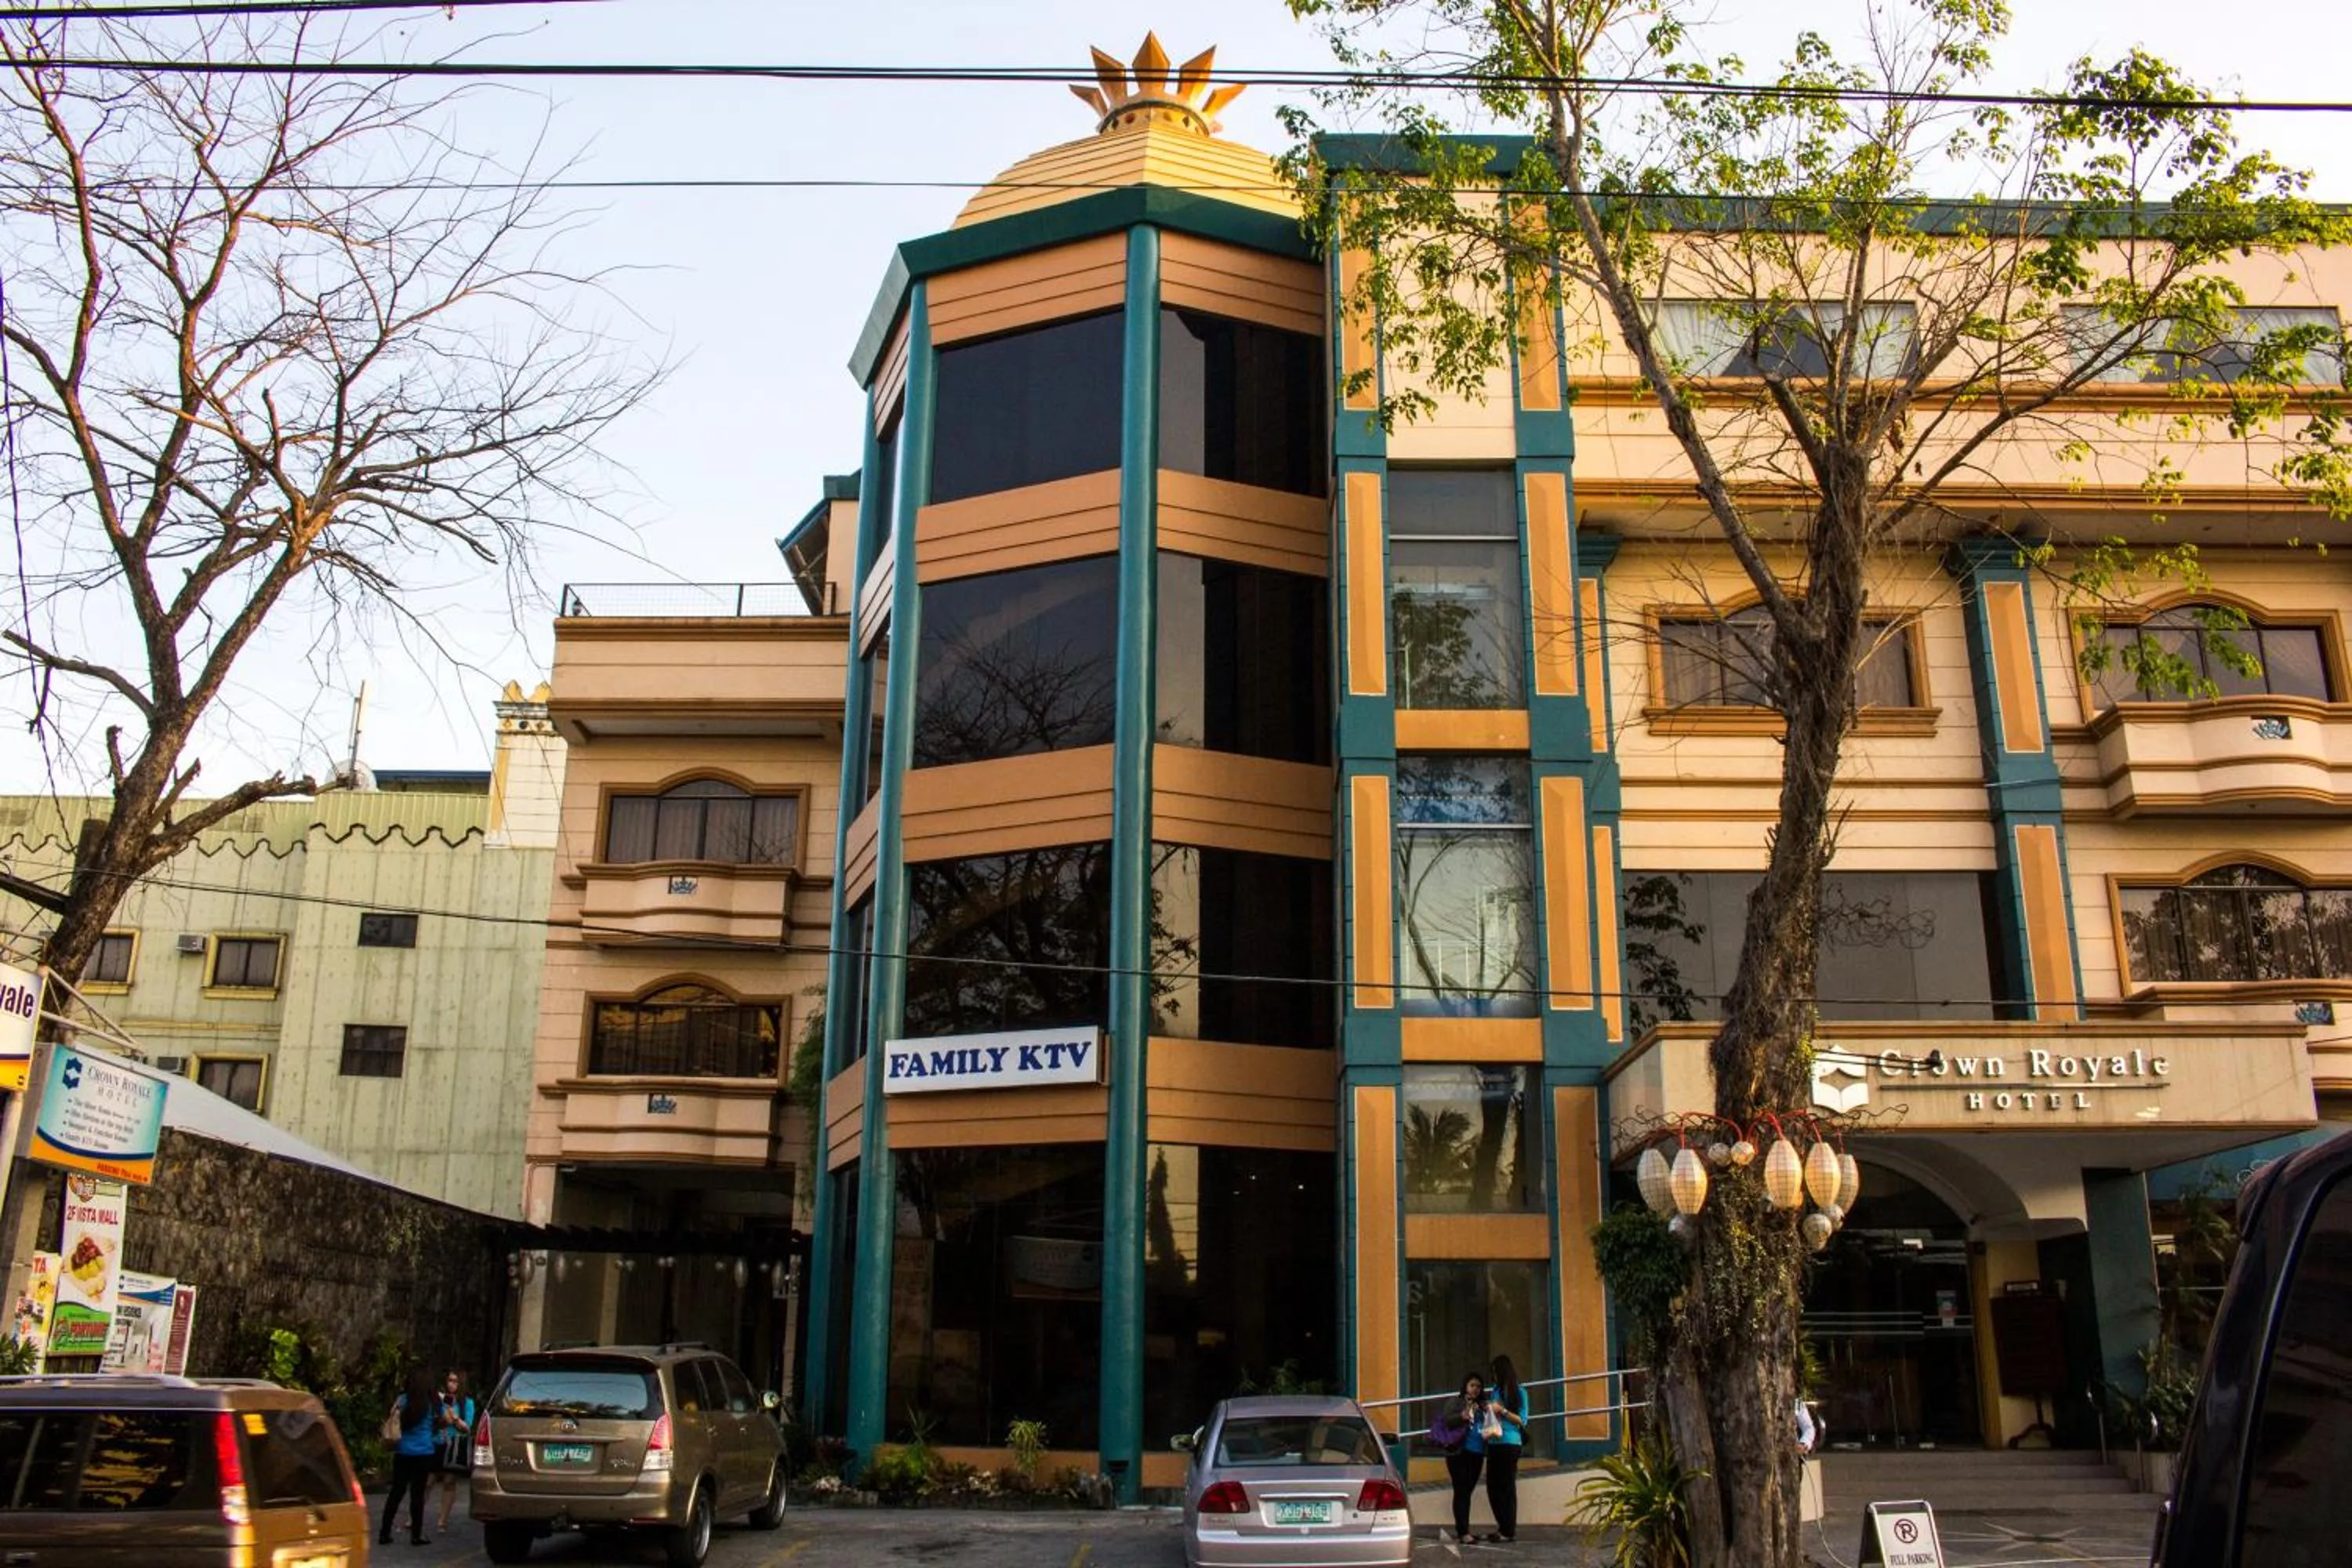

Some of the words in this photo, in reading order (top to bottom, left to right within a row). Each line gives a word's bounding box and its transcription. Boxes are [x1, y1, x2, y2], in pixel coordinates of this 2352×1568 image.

[888, 1047, 1010, 1078] FAMILY
[1017, 1041, 1092, 1071] KTV
[1879, 1048, 2006, 1077] Crown
[2029, 1048, 2170, 1081] Royale
[1968, 1092, 2091, 1109] HOTEL
